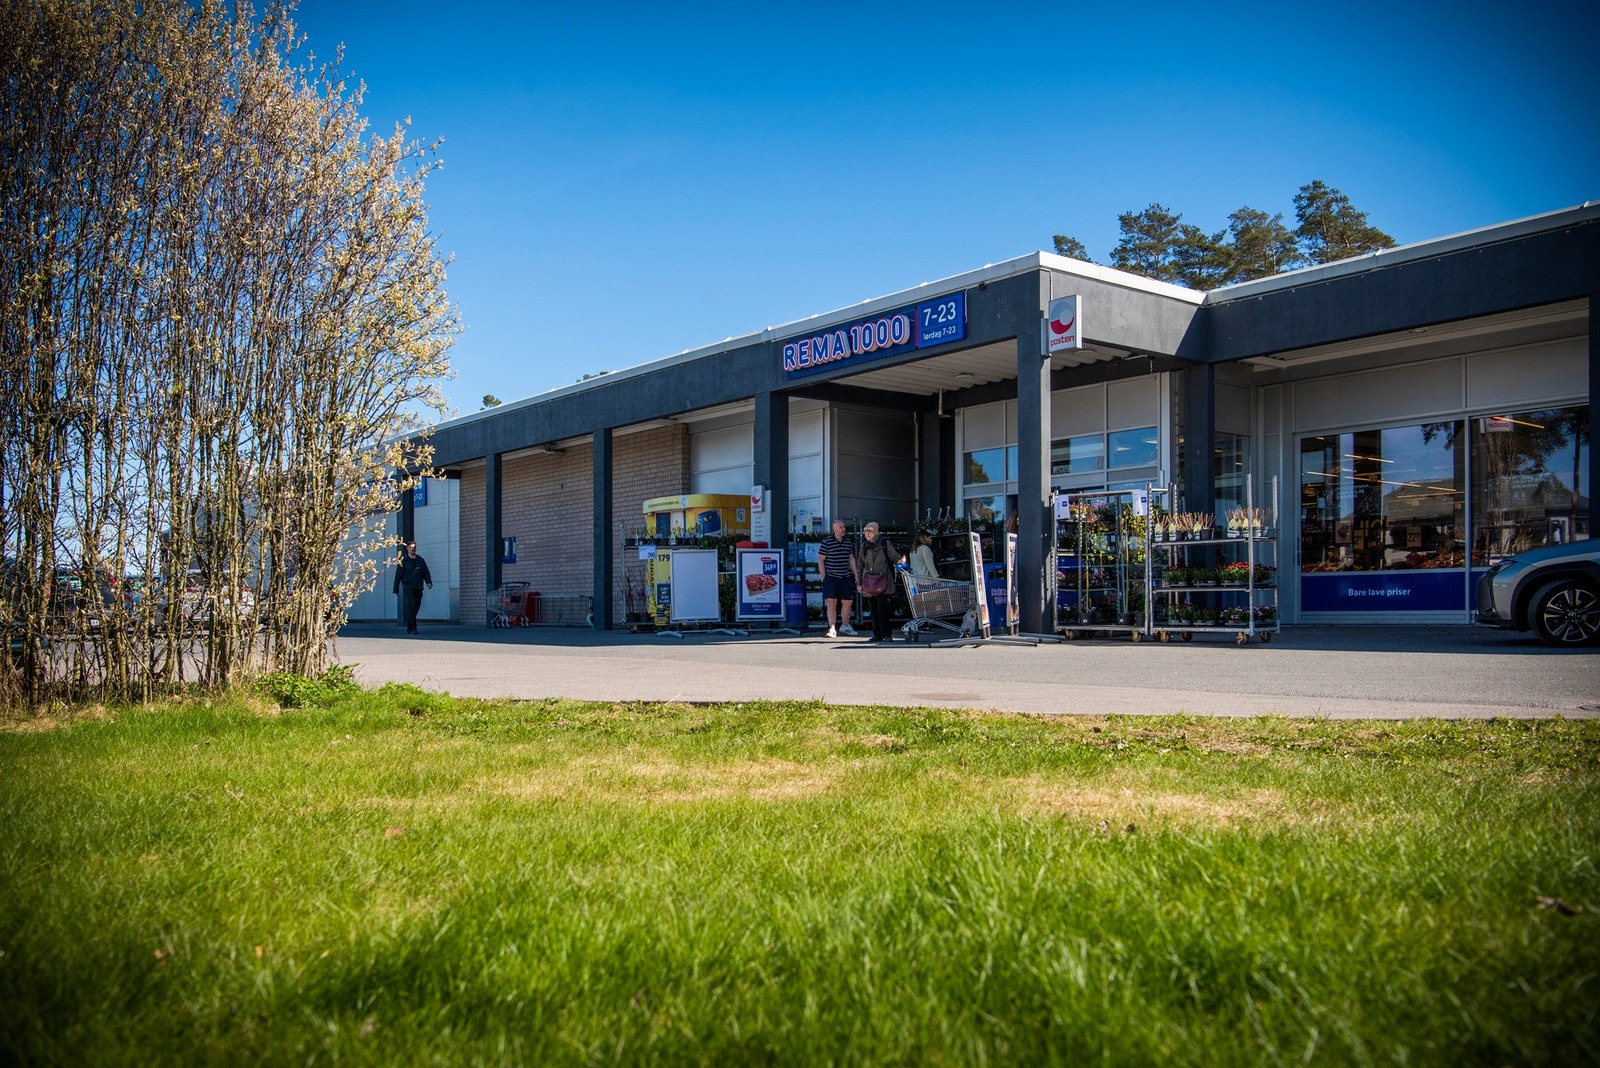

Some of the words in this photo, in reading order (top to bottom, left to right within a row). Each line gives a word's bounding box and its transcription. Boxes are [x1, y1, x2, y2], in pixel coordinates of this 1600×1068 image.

[923, 301, 956, 326] 7-23
[942, 325, 956, 336] 7-23
[783, 330, 850, 371] REMA
[851, 313, 908, 355] 1000
[1050, 334, 1075, 348] posten
[658, 554, 671, 562] 179
[1348, 588, 1367, 596] Bare
[1368, 587, 1385, 596] lave
[1386, 587, 1412, 597] priser
